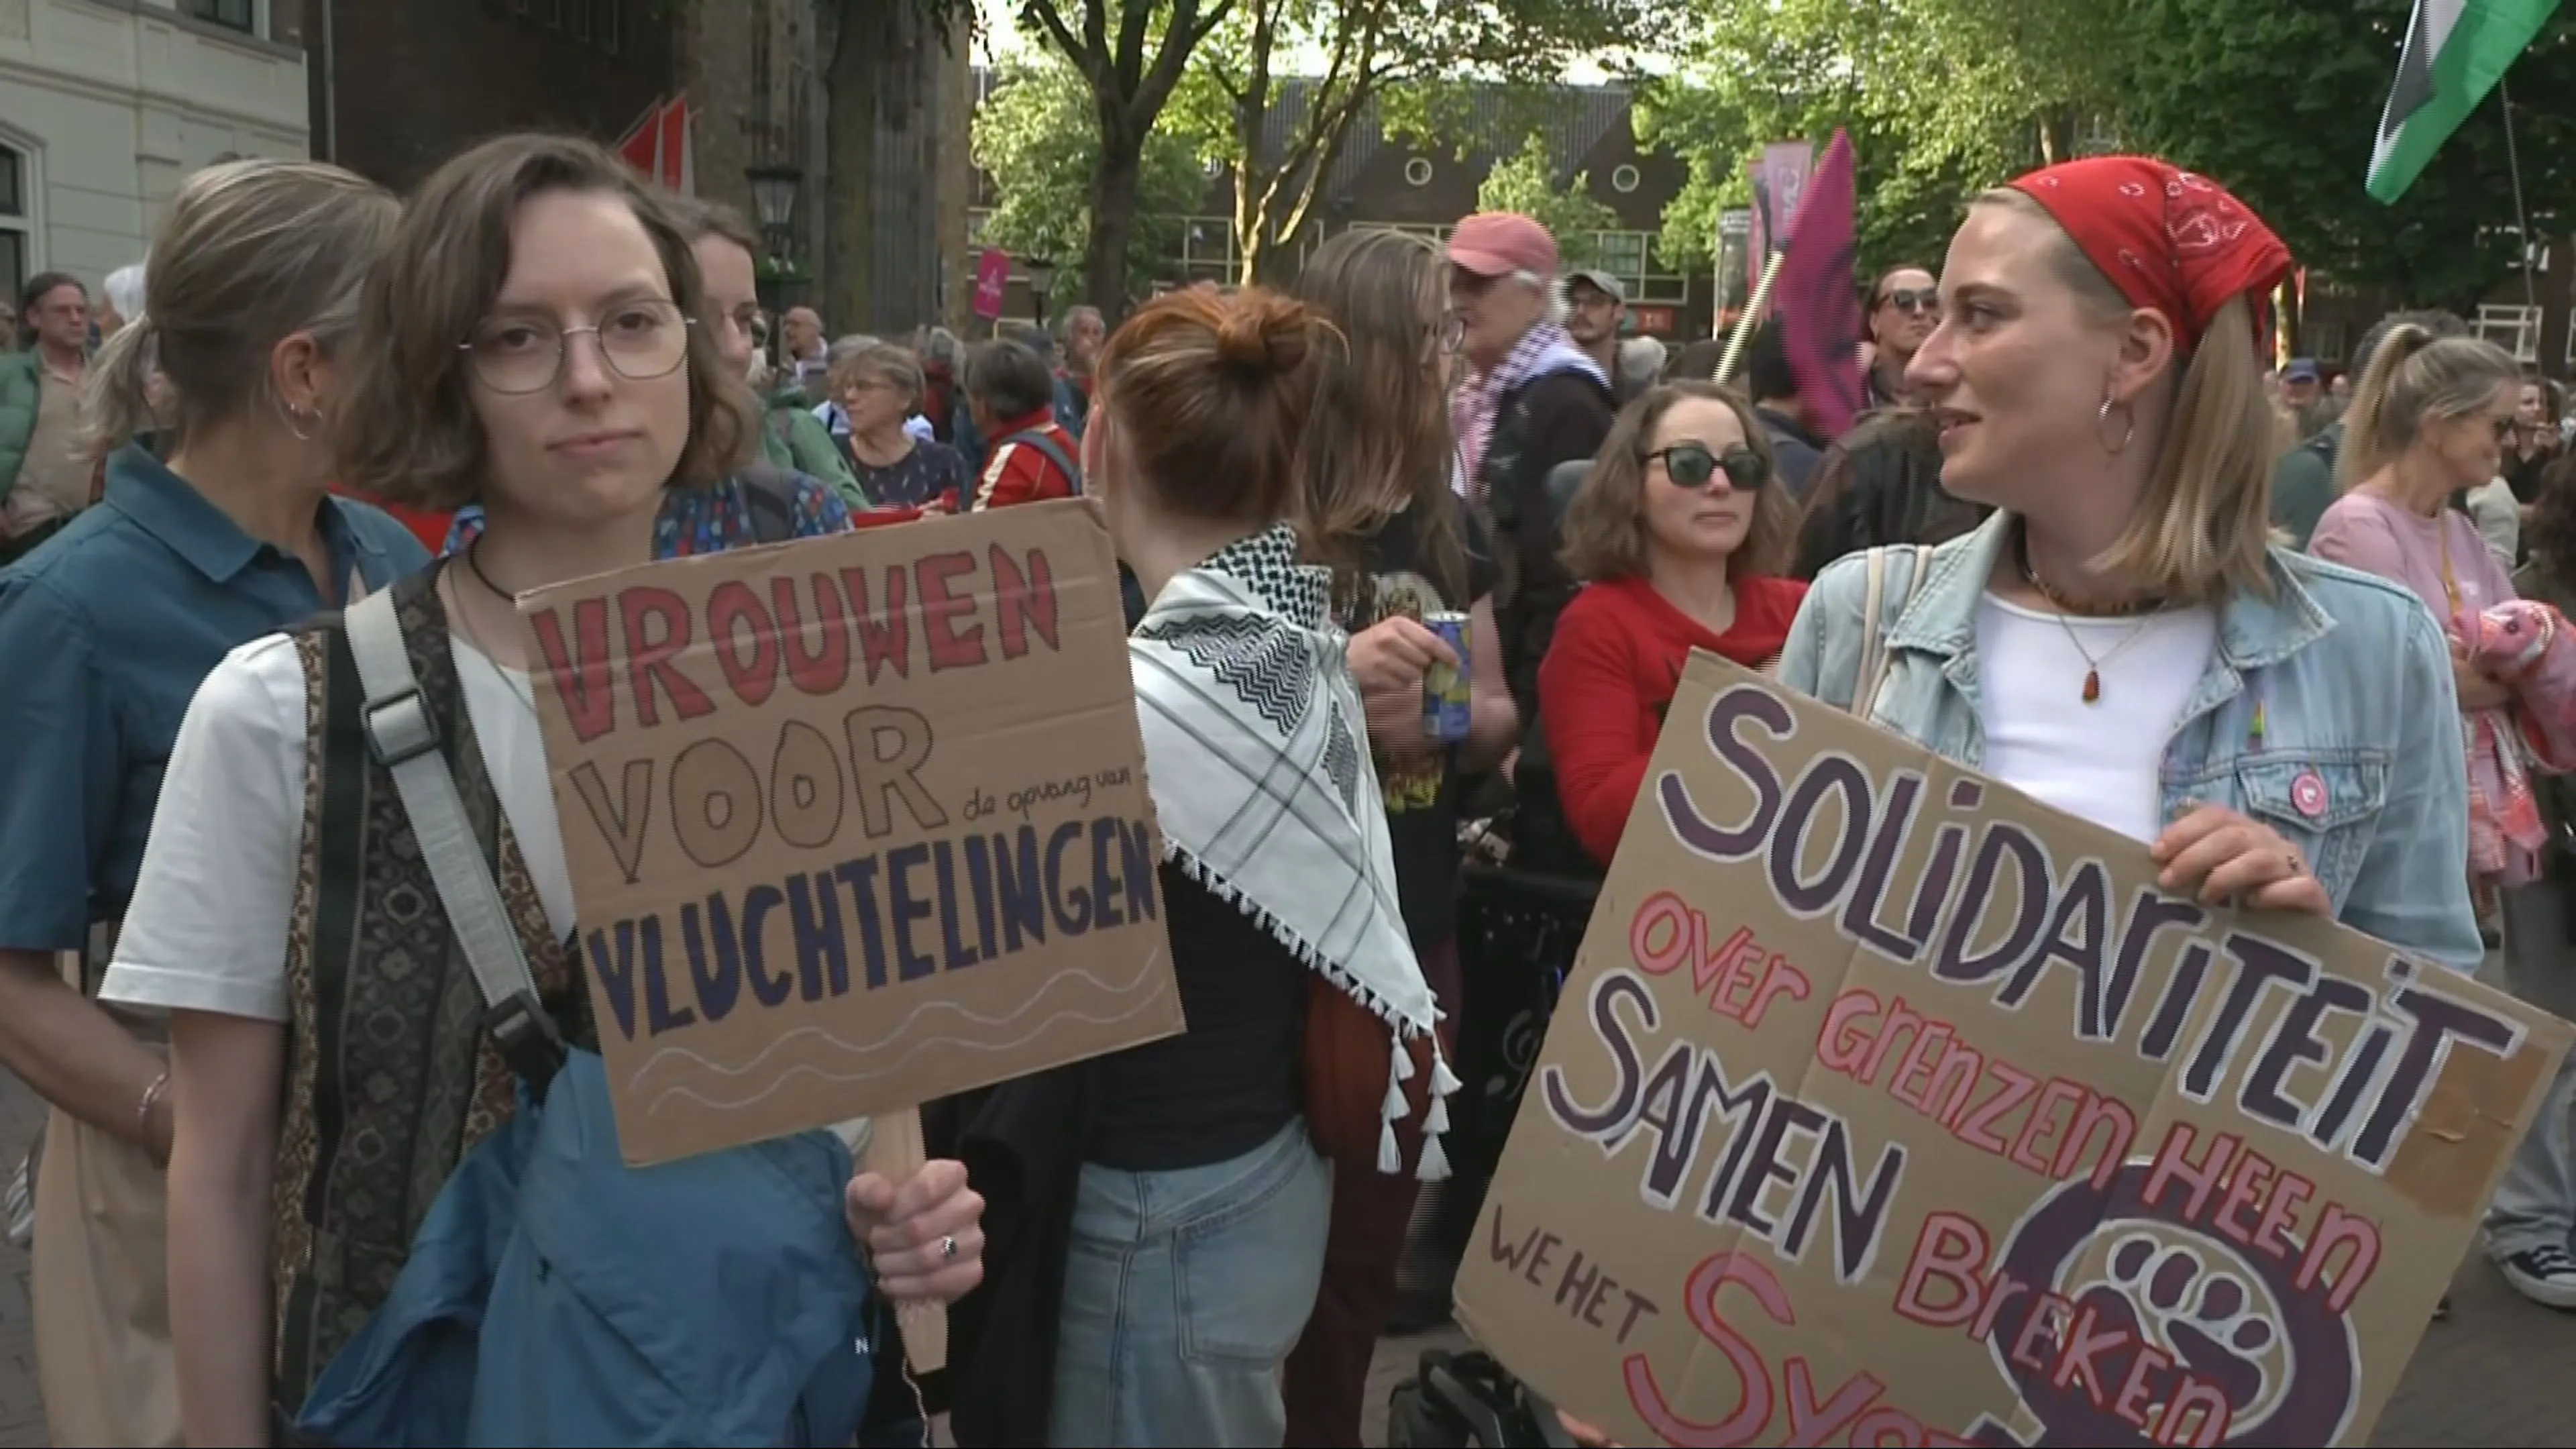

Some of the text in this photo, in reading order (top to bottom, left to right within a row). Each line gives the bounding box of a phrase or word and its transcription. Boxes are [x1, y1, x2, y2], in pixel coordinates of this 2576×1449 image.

[530, 541, 1060, 743] VROUWEN
[568, 704, 1132, 885] VOOR de opvang van
[586, 816, 1157, 1042] VLUCHTELINGEN
[1542, 967, 1908, 1285] SAMEN
[1490, 1203, 1563, 1287] WE
[1554, 1248, 1661, 1346] HET
